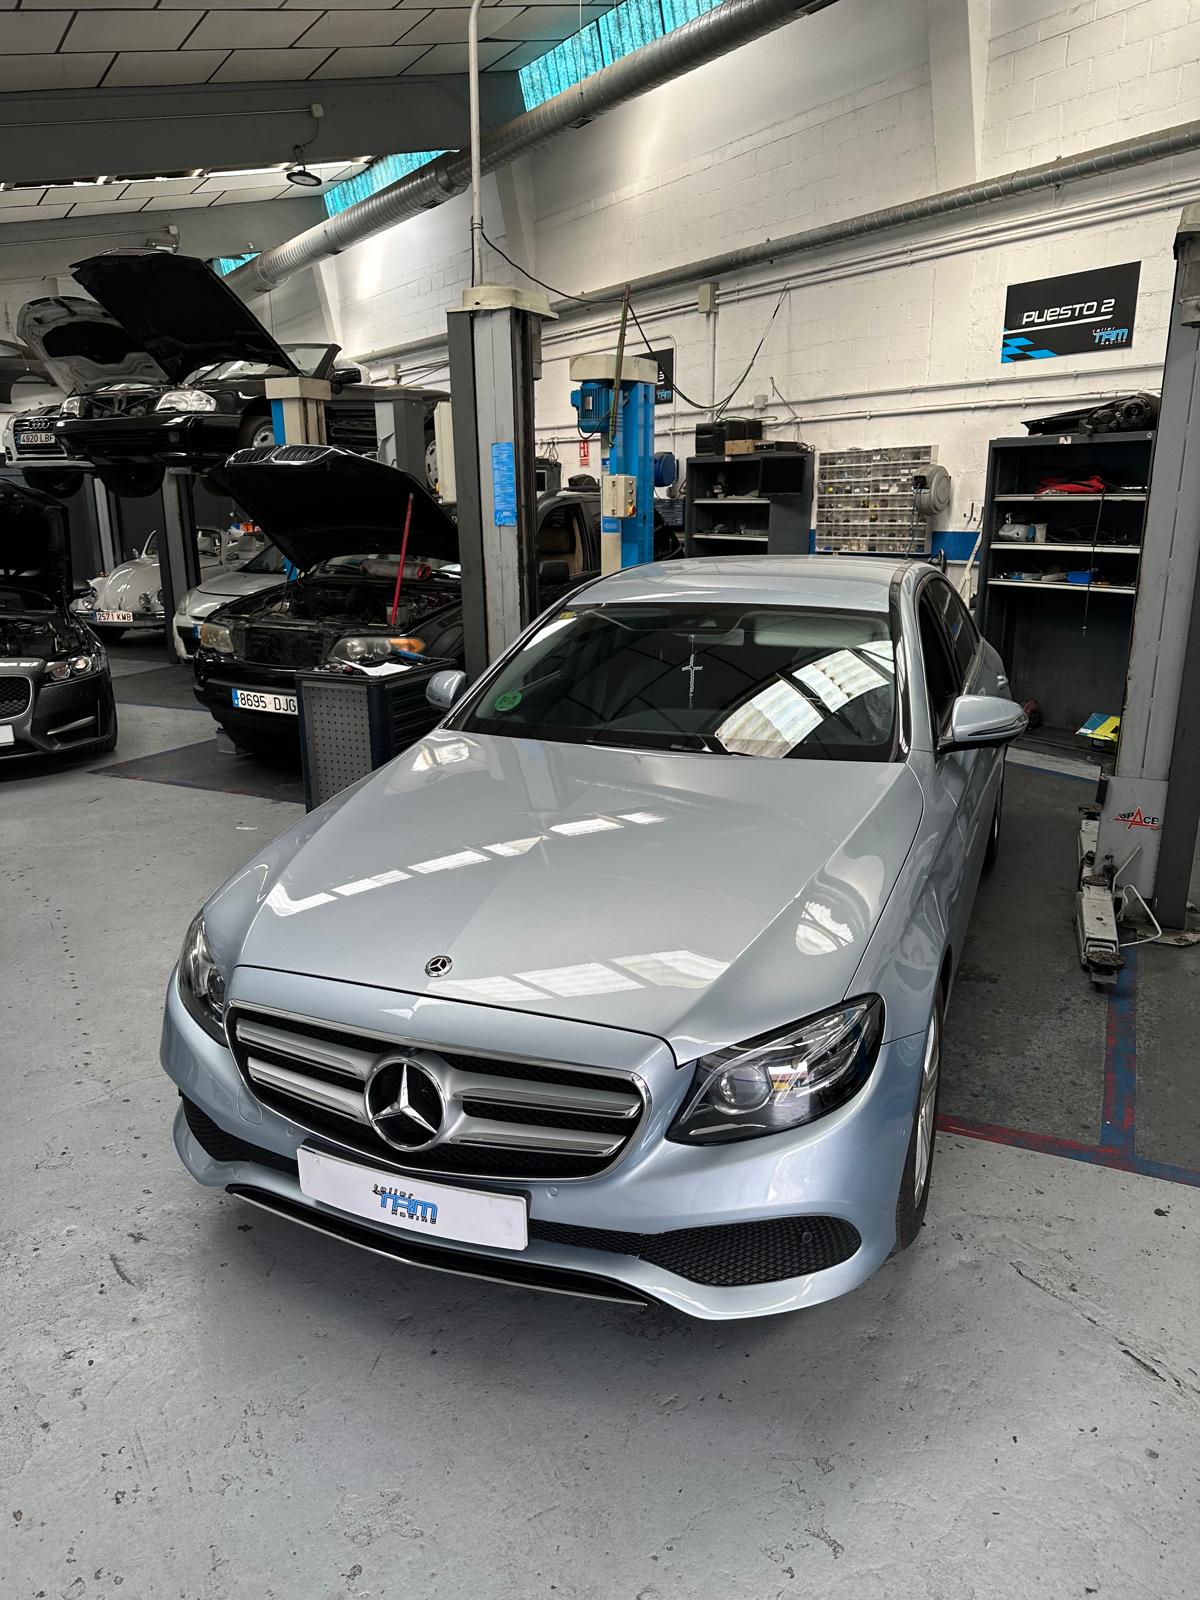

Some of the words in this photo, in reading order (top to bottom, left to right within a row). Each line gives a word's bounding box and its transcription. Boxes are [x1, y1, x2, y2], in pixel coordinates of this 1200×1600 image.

[1100, 298, 1116, 313] 2
[21, 433, 39, 444] 4920
[97, 612, 115, 621] 2571
[239, 692, 267, 709] 8695
[273, 696, 297, 713] DJG
[1118, 806, 1160, 829] SPACE
